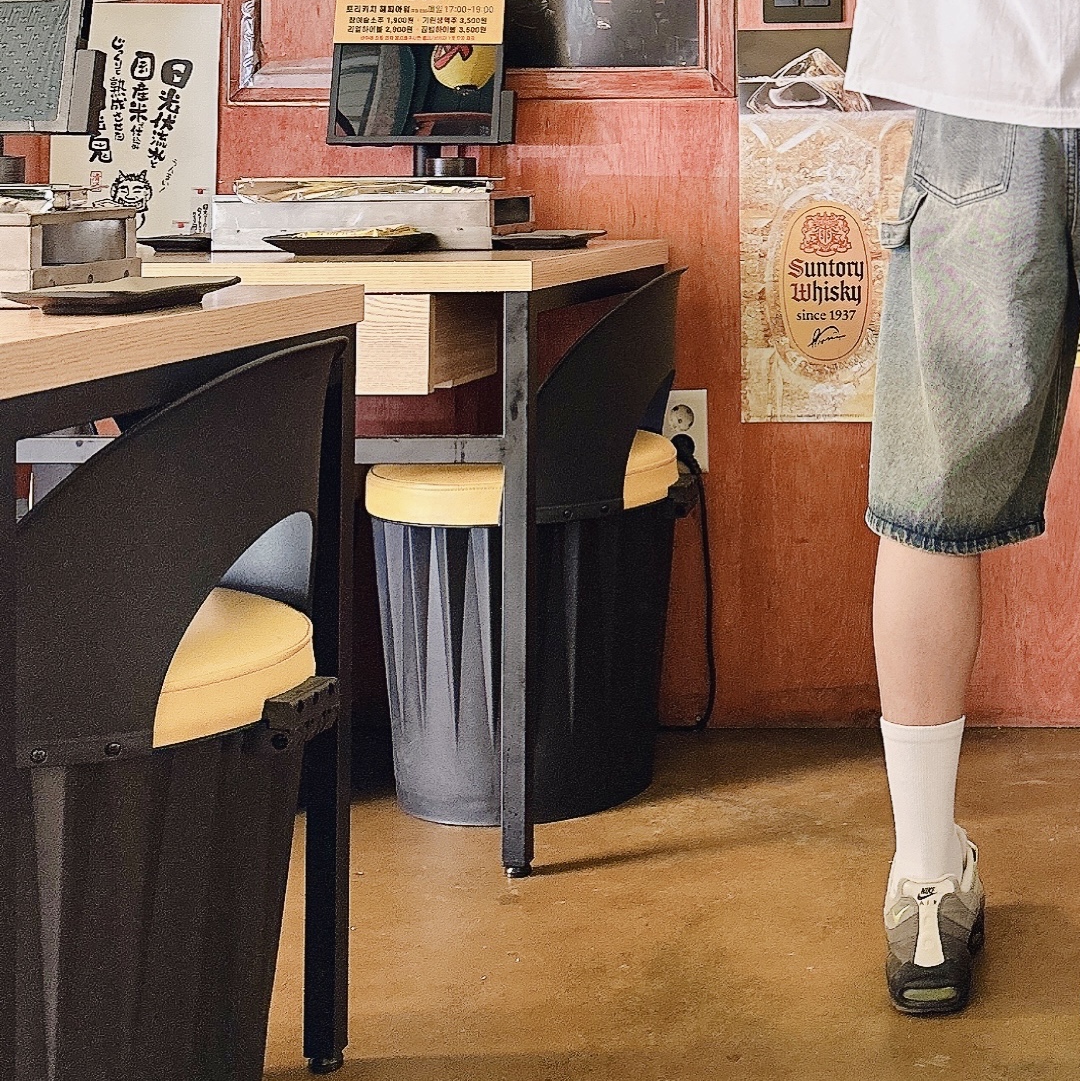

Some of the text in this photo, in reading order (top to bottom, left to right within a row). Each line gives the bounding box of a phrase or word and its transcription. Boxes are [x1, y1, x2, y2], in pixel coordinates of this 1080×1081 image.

[788, 258, 864, 281] Suntory
[790, 280, 861, 306] Whisky
[796, 309, 856, 320] since 1937
